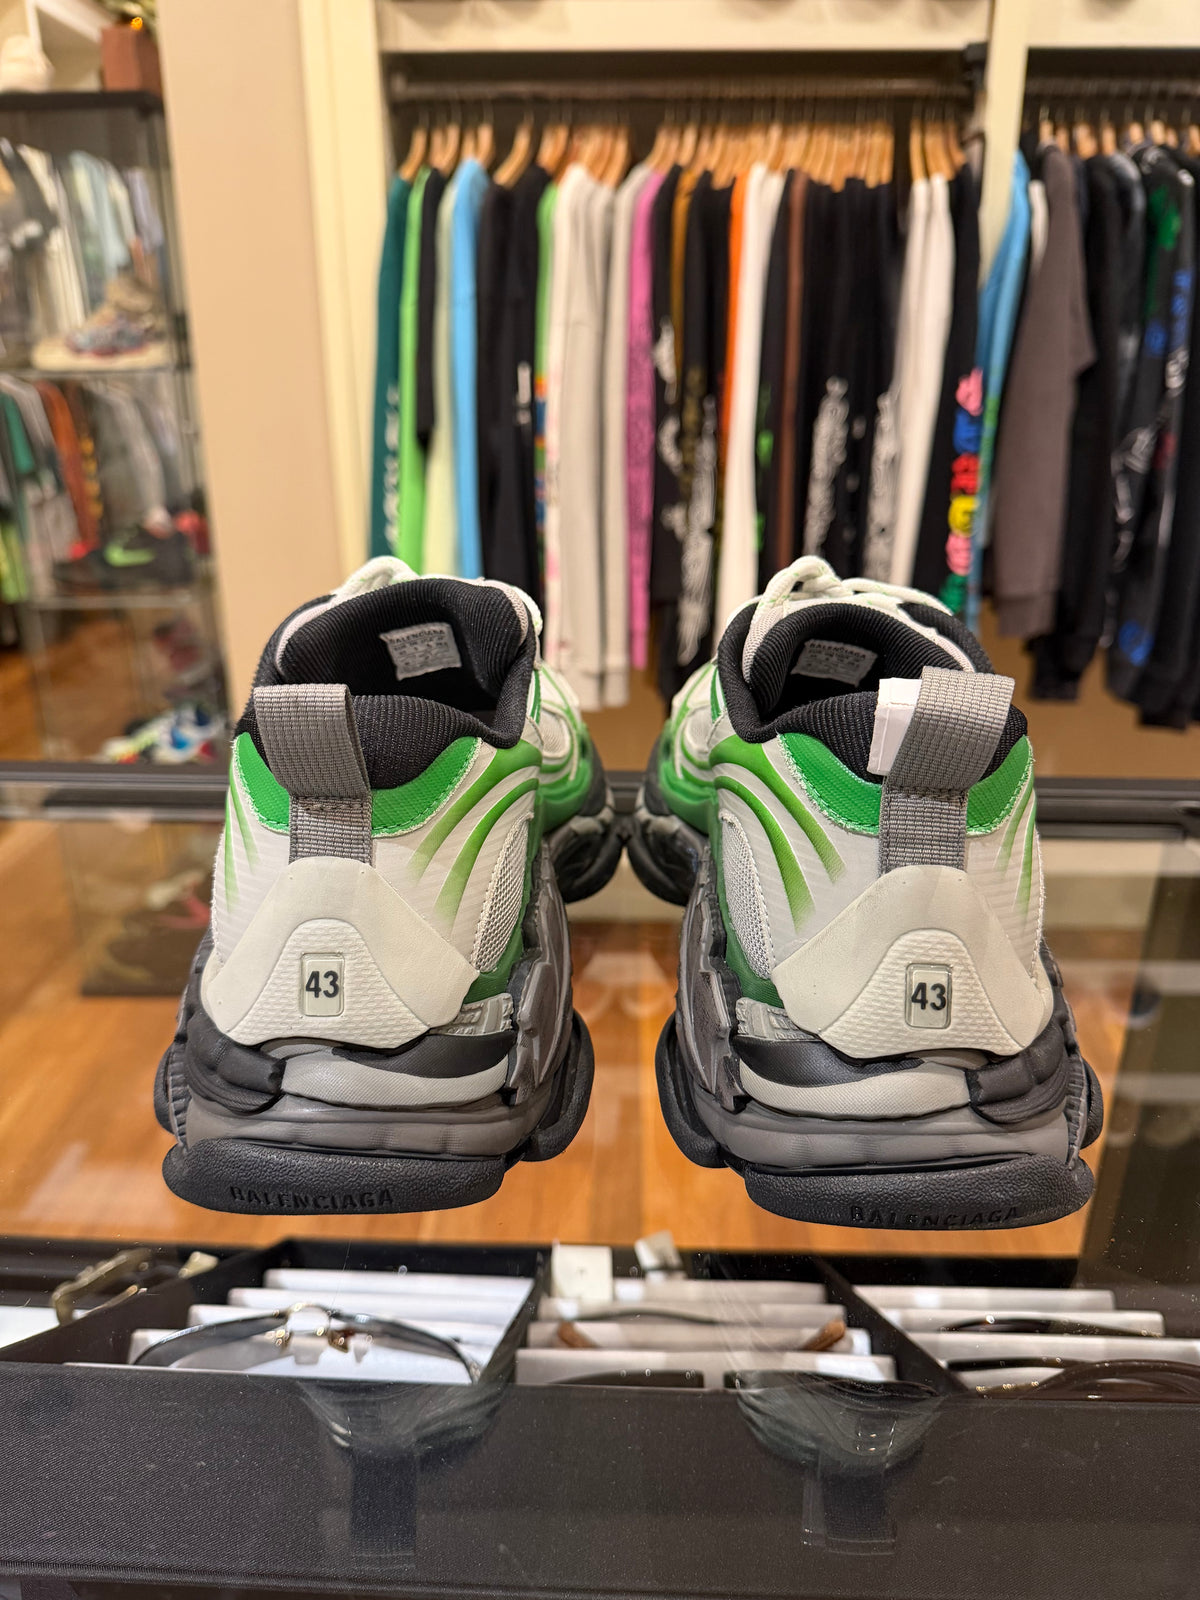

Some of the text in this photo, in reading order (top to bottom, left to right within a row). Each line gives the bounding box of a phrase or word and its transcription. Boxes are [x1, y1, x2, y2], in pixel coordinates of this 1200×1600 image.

[305, 970, 340, 998] 43
[911, 982, 947, 1011] 43
[230, 1186, 394, 1209] BALENCIAGA
[850, 1205, 1019, 1226] BALENCIAGA
